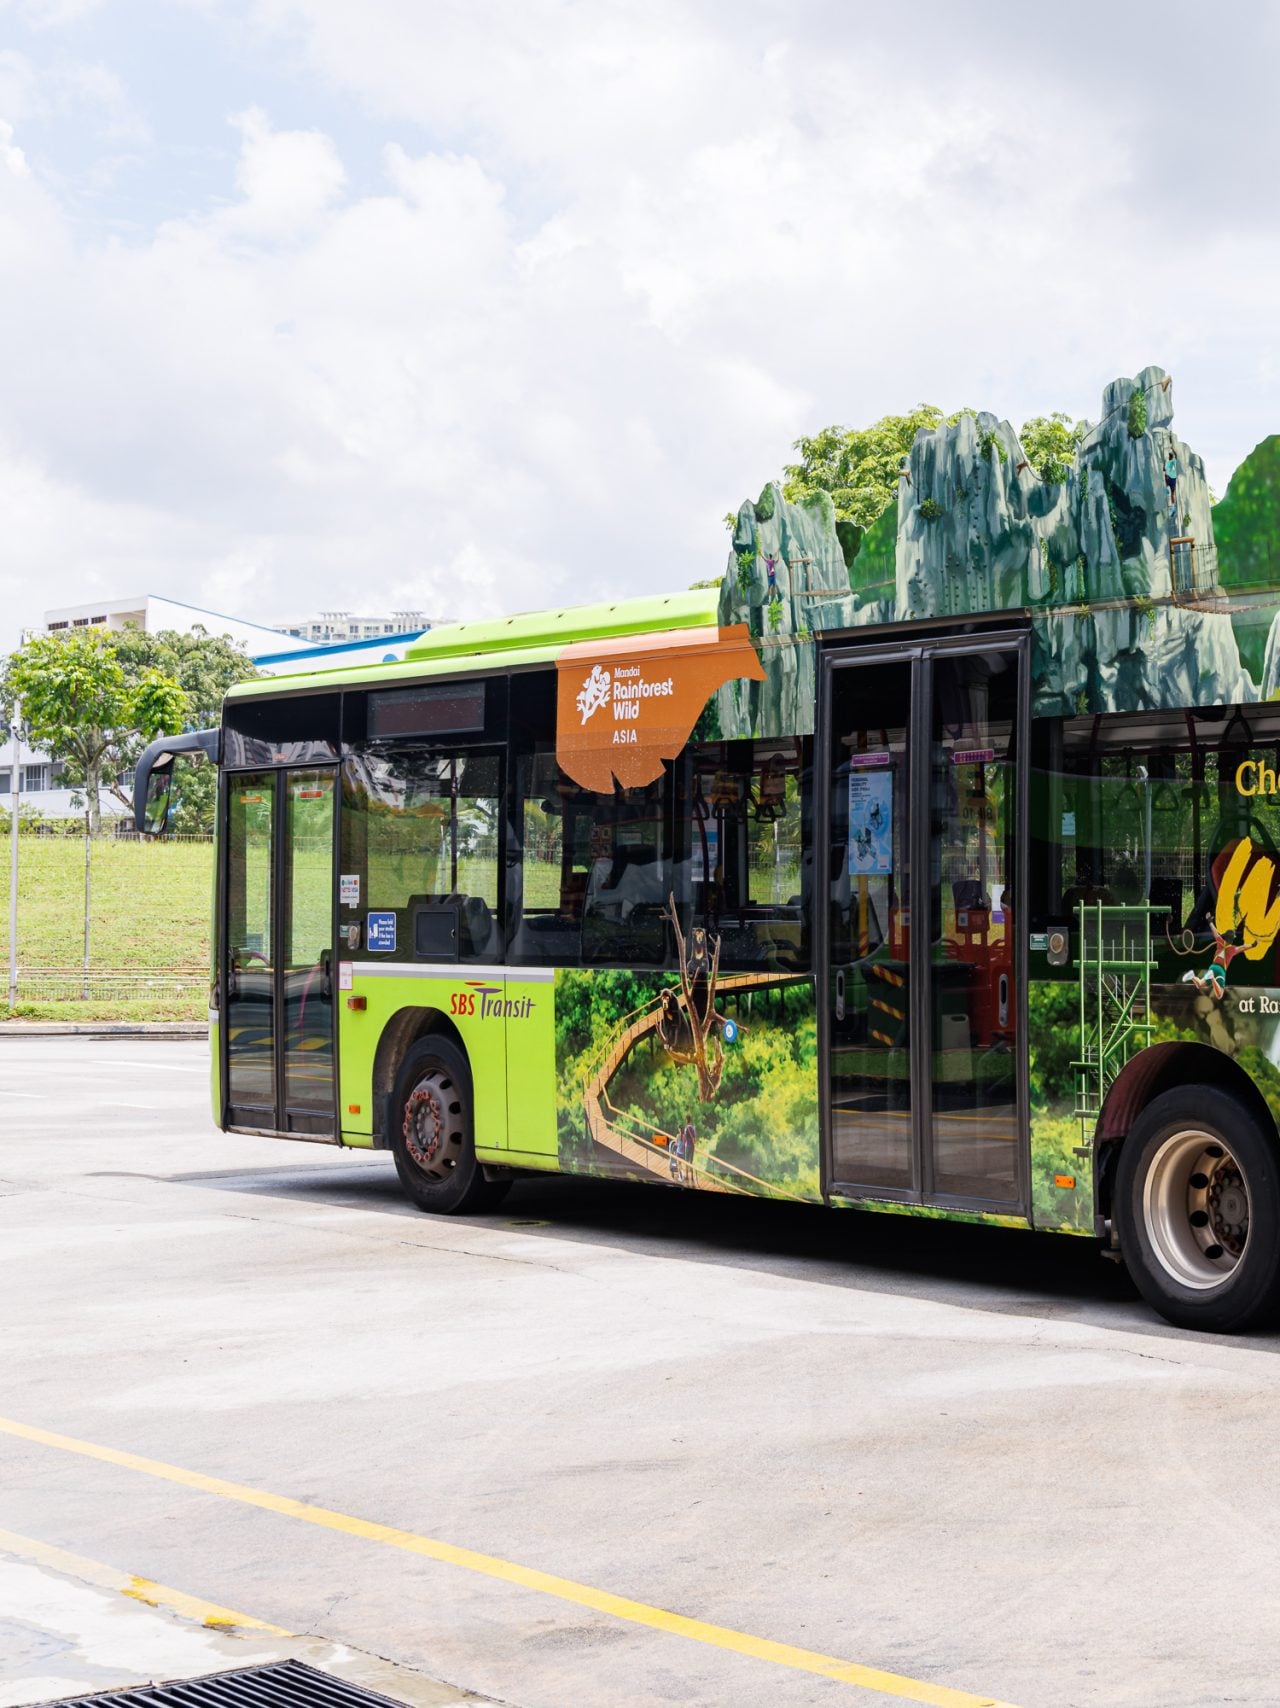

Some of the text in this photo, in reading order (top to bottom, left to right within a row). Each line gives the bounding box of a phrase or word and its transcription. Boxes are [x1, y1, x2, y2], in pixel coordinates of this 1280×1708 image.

[614, 665, 641, 678] Mandai
[613, 678, 673, 700] Rainforest
[613, 700, 640, 720] Wild
[612, 729, 638, 744] ASIA
[450, 988, 536, 1020] SBS Transit
[1239, 996, 1256, 1013] at
